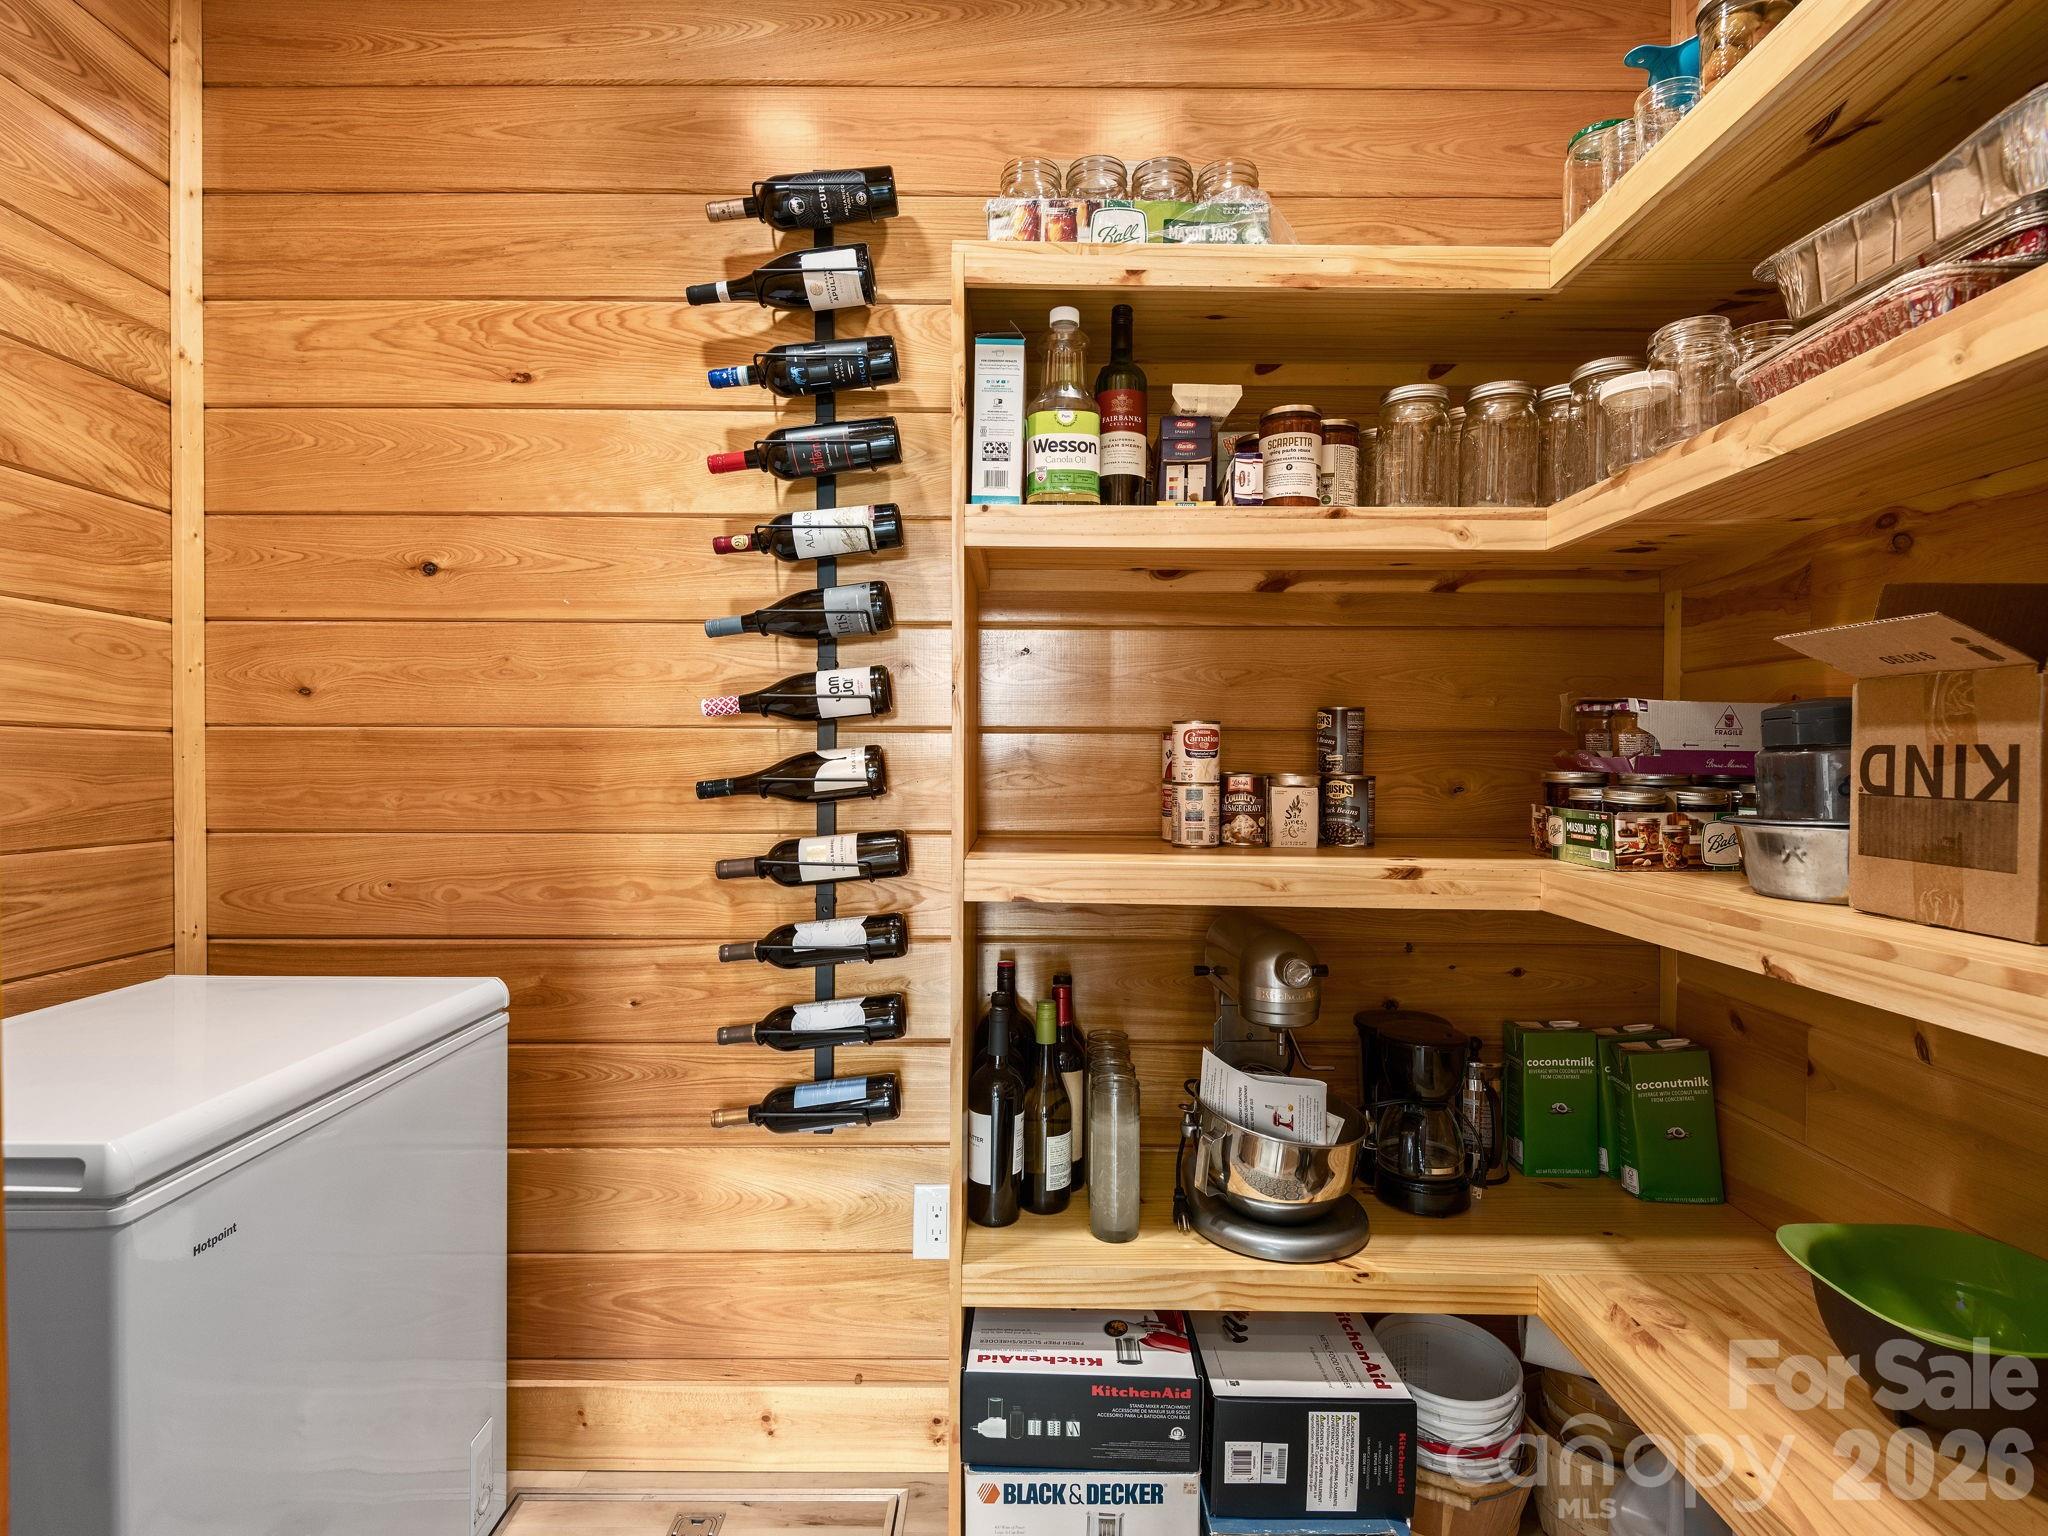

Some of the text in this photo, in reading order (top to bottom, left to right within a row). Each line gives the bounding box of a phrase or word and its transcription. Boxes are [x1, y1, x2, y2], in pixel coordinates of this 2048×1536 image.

[818, 178, 832, 224] EPICURO
[1168, 224, 1238, 241] MASON JARS
[1102, 414, 1142, 424] FAIRBANKS
[1033, 438, 1097, 454] Wesson
[1268, 436, 1312, 450] SCARPETTA
[1045, 456, 1086, 464] Canola Oil
[803, 512, 816, 548] ALAMOS
[1185, 732, 1218, 744] Carnation
[1860, 744, 2020, 803] KIND
[1224, 792, 1256, 804] Country
[1244, 804, 1261, 812] GRAVY
[1337, 807, 1358, 816] Beans
[1566, 822, 1597, 835] MASON JARS
[1527, 1057, 1594, 1066] coconutmilk
[1636, 1076, 1710, 1090] coconutmilk
[193, 1222, 237, 1256] Hotpoint
[1335, 1312, 1392, 1390] itchenAid
[977, 1354, 1103, 1366] KitchenAid
[1328, 1351, 1340, 1366] FOOD
[1335, 1366, 1352, 1389] GRINDER
[1091, 1385, 1192, 1398] KitchenAid
[1397, 1432, 1406, 1495] KitchenAid
